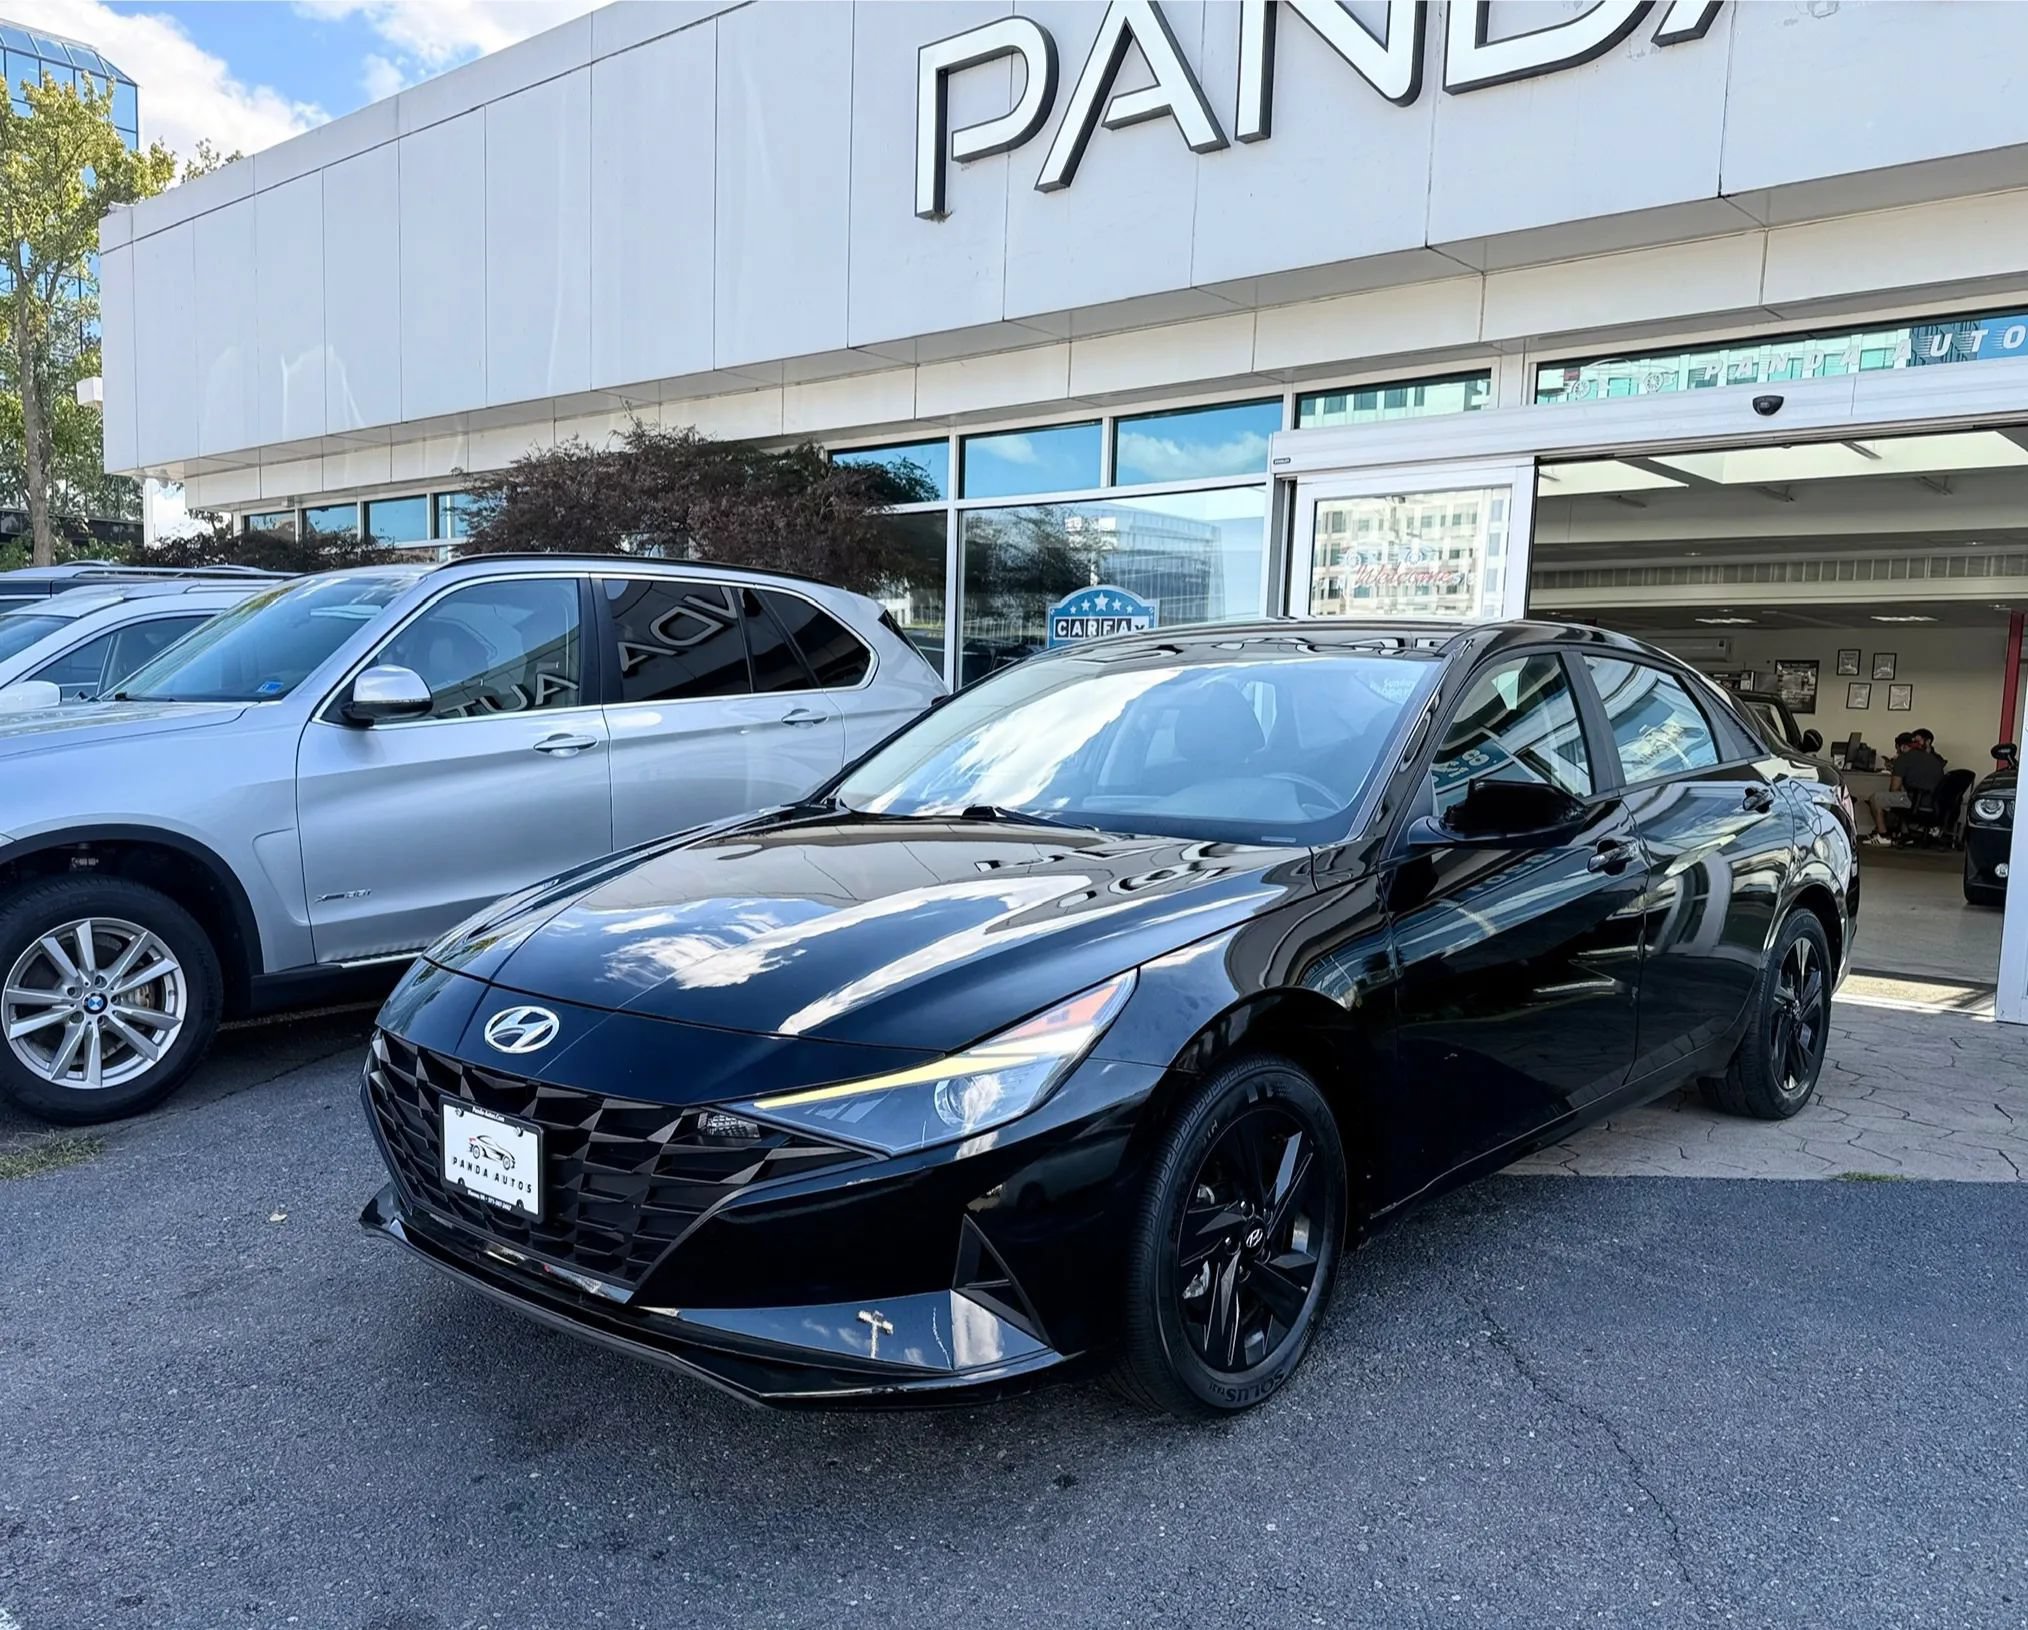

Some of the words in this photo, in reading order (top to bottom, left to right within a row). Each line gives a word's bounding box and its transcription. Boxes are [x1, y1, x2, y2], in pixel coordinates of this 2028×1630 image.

[914, 0, 1725, 220] PAND
[1703, 341, 1862, 381] PANDA
[1892, 322, 2028, 370] AUTO
[452, 1157, 488, 1177] PANDA
[494, 1173, 532, 1193] AUTOS
[1225, 1368, 1288, 1403] SOLUS
